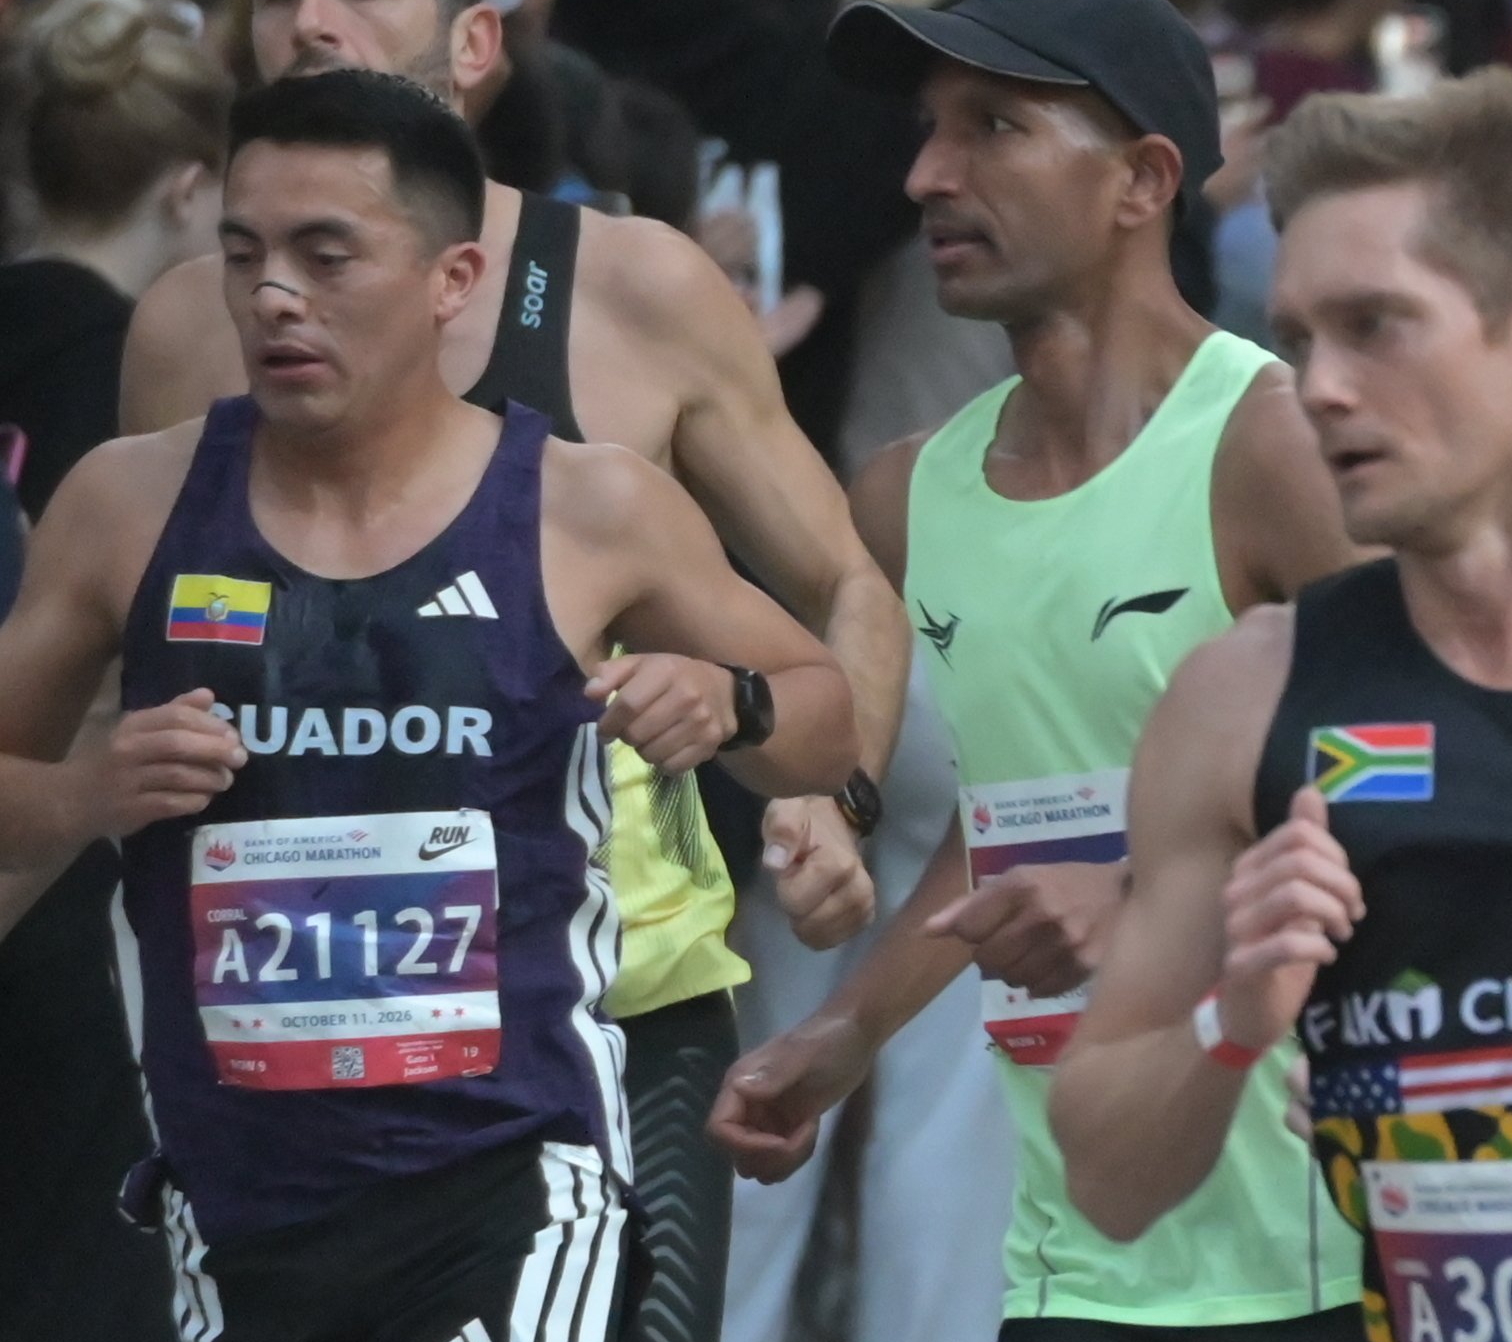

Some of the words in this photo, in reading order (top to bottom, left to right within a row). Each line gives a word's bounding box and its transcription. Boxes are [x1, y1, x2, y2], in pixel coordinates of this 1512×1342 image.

[521, 260, 548, 329] soar
[211, 703, 493, 757] UADOR
[429, 826, 470, 845] RUN
[244, 850, 301, 866] CHICAGO
[305, 847, 382, 861] MARATHON
[212, 905, 482, 984] A21127
[282, 1014, 346, 1028] OCTOBER
[378, 1010, 413, 1023] 2026
